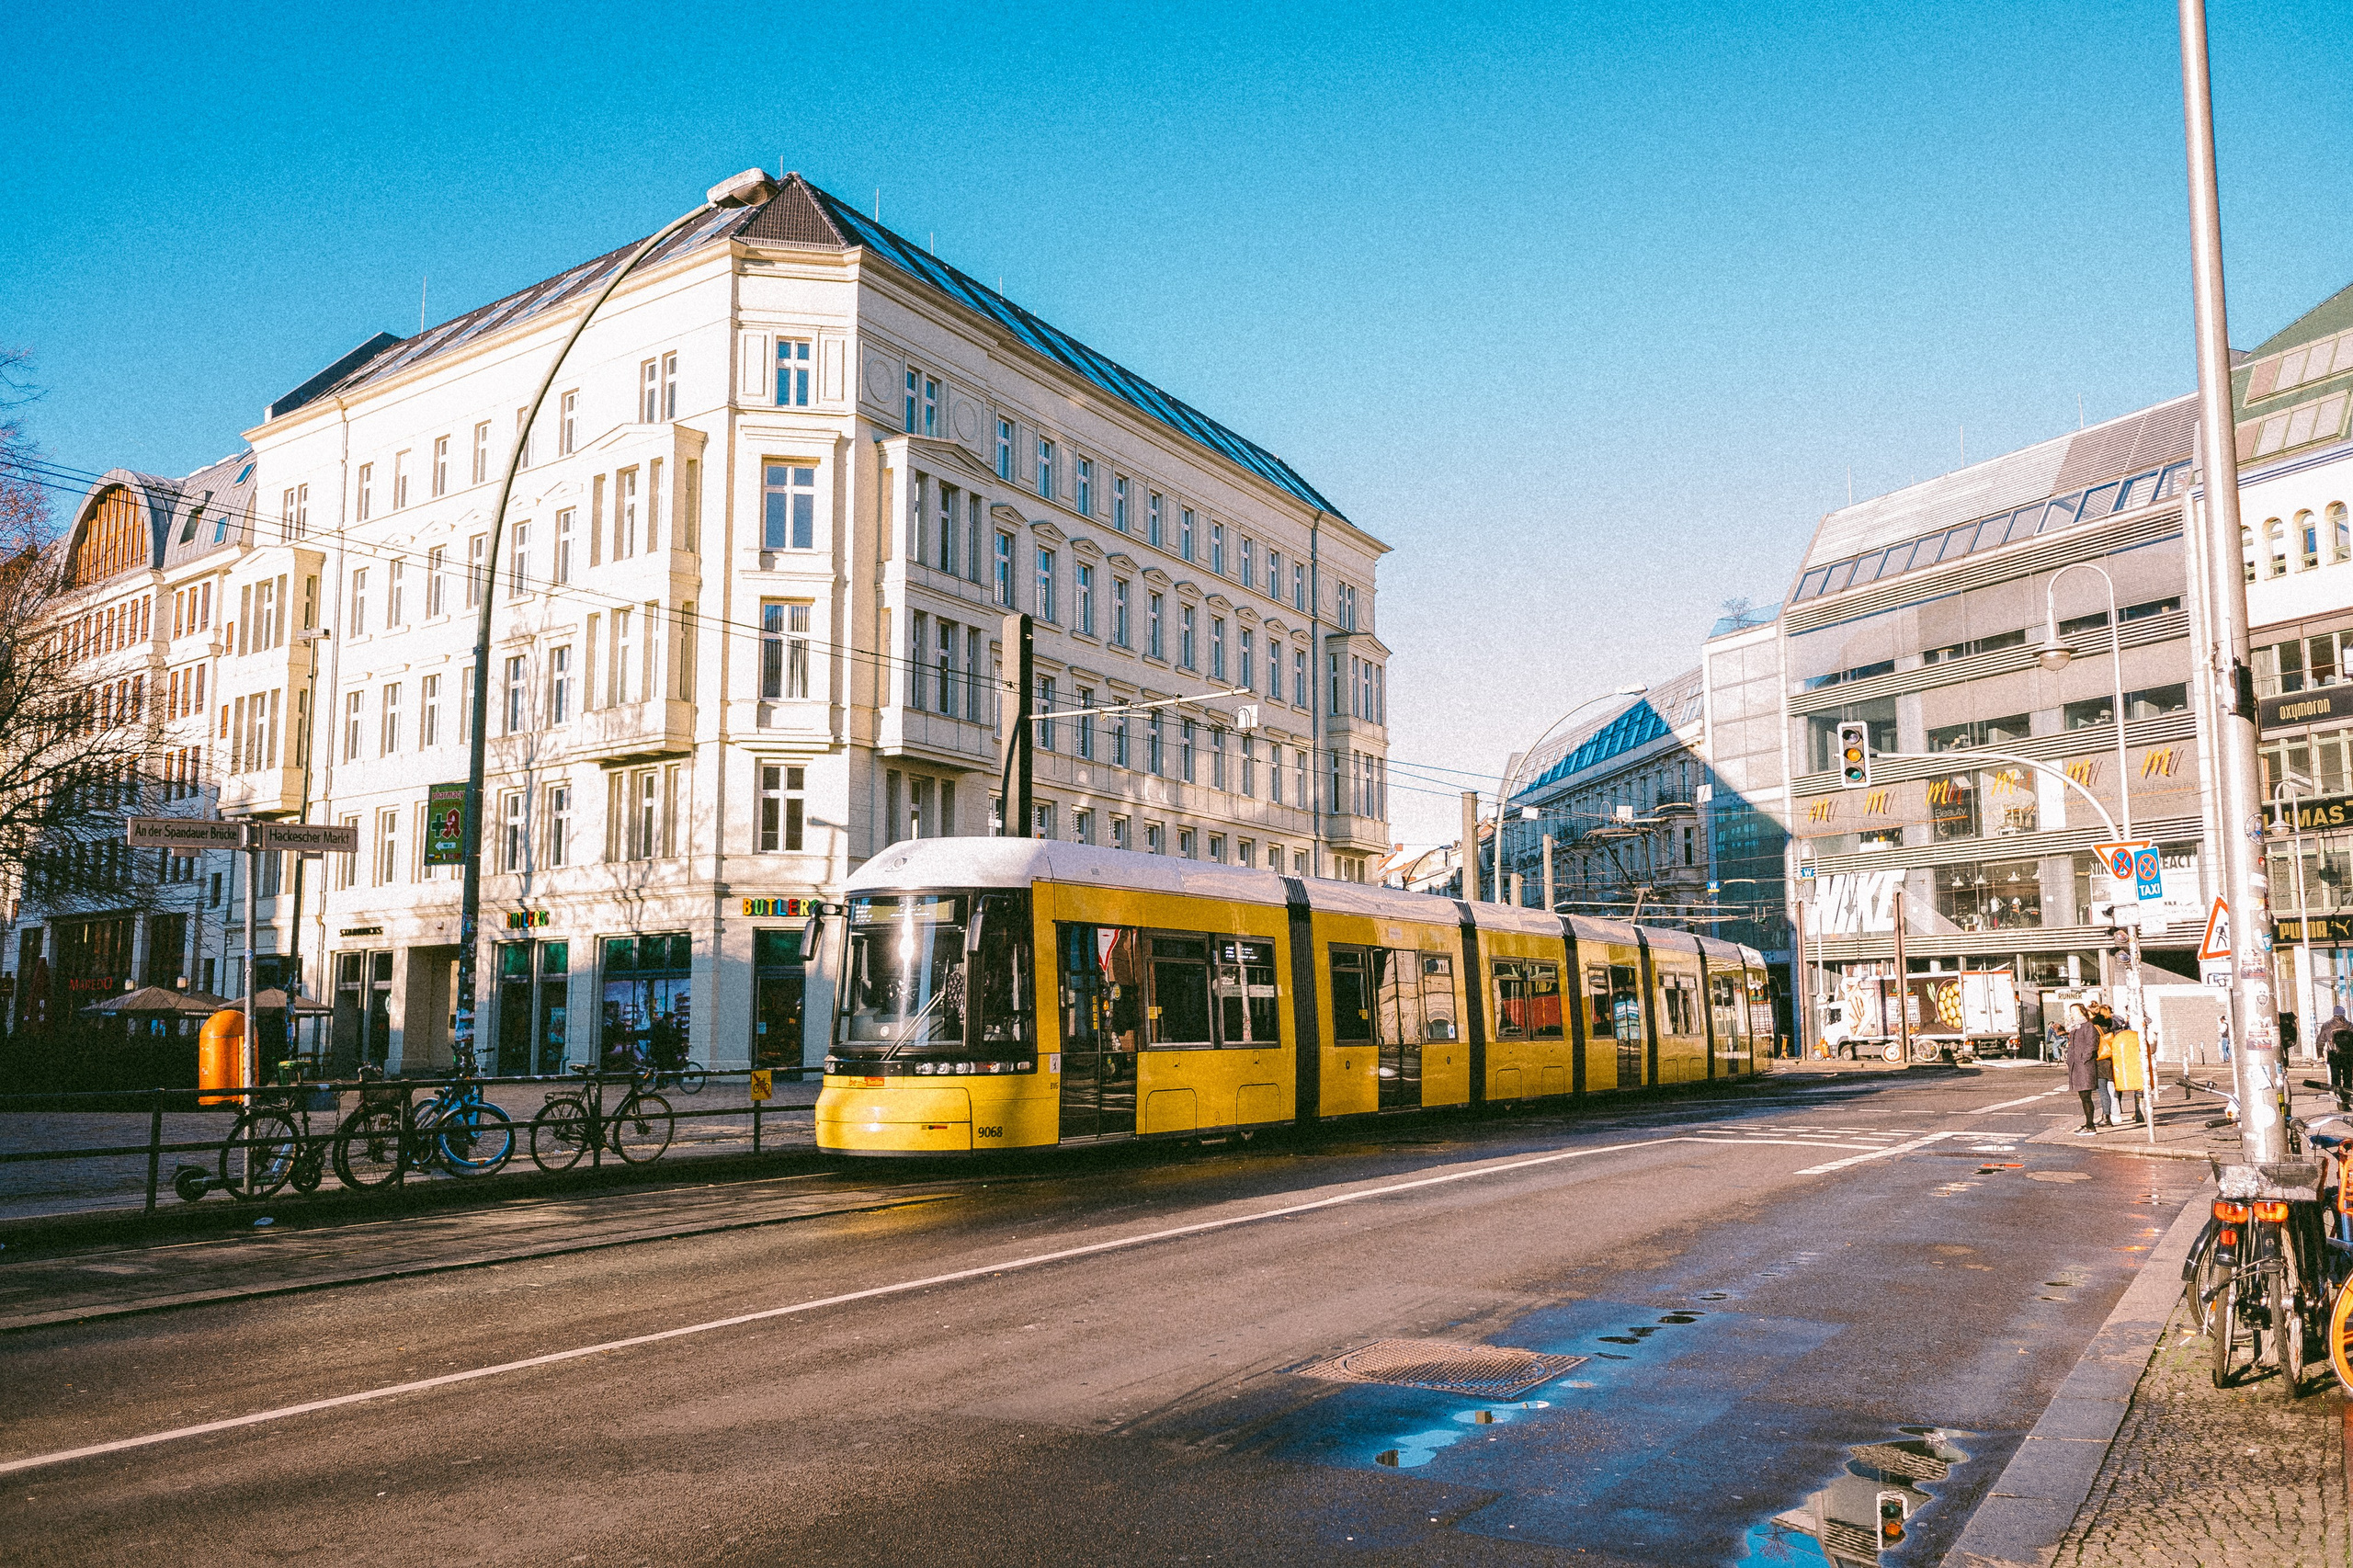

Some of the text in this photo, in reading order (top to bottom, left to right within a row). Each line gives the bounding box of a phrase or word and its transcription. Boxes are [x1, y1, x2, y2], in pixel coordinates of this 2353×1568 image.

[431, 791, 465, 801] pharmacy
[1935, 807, 1966, 818] Beauty
[135, 824, 237, 840] An der Spandauer Brücke
[269, 829, 350, 844] Hackescher Markt
[1804, 869, 1813, 877] W
[2090, 856, 2193, 875] NIK EACT
[2139, 883, 2161, 896] TAXI
[1806, 869, 1906, 935] NIKE
[506, 911, 547, 928] BUTLERS
[2279, 921, 2327, 939] PUMA
[69, 976, 113, 992] MAREDO
[978, 1126, 1004, 1139] 9068
